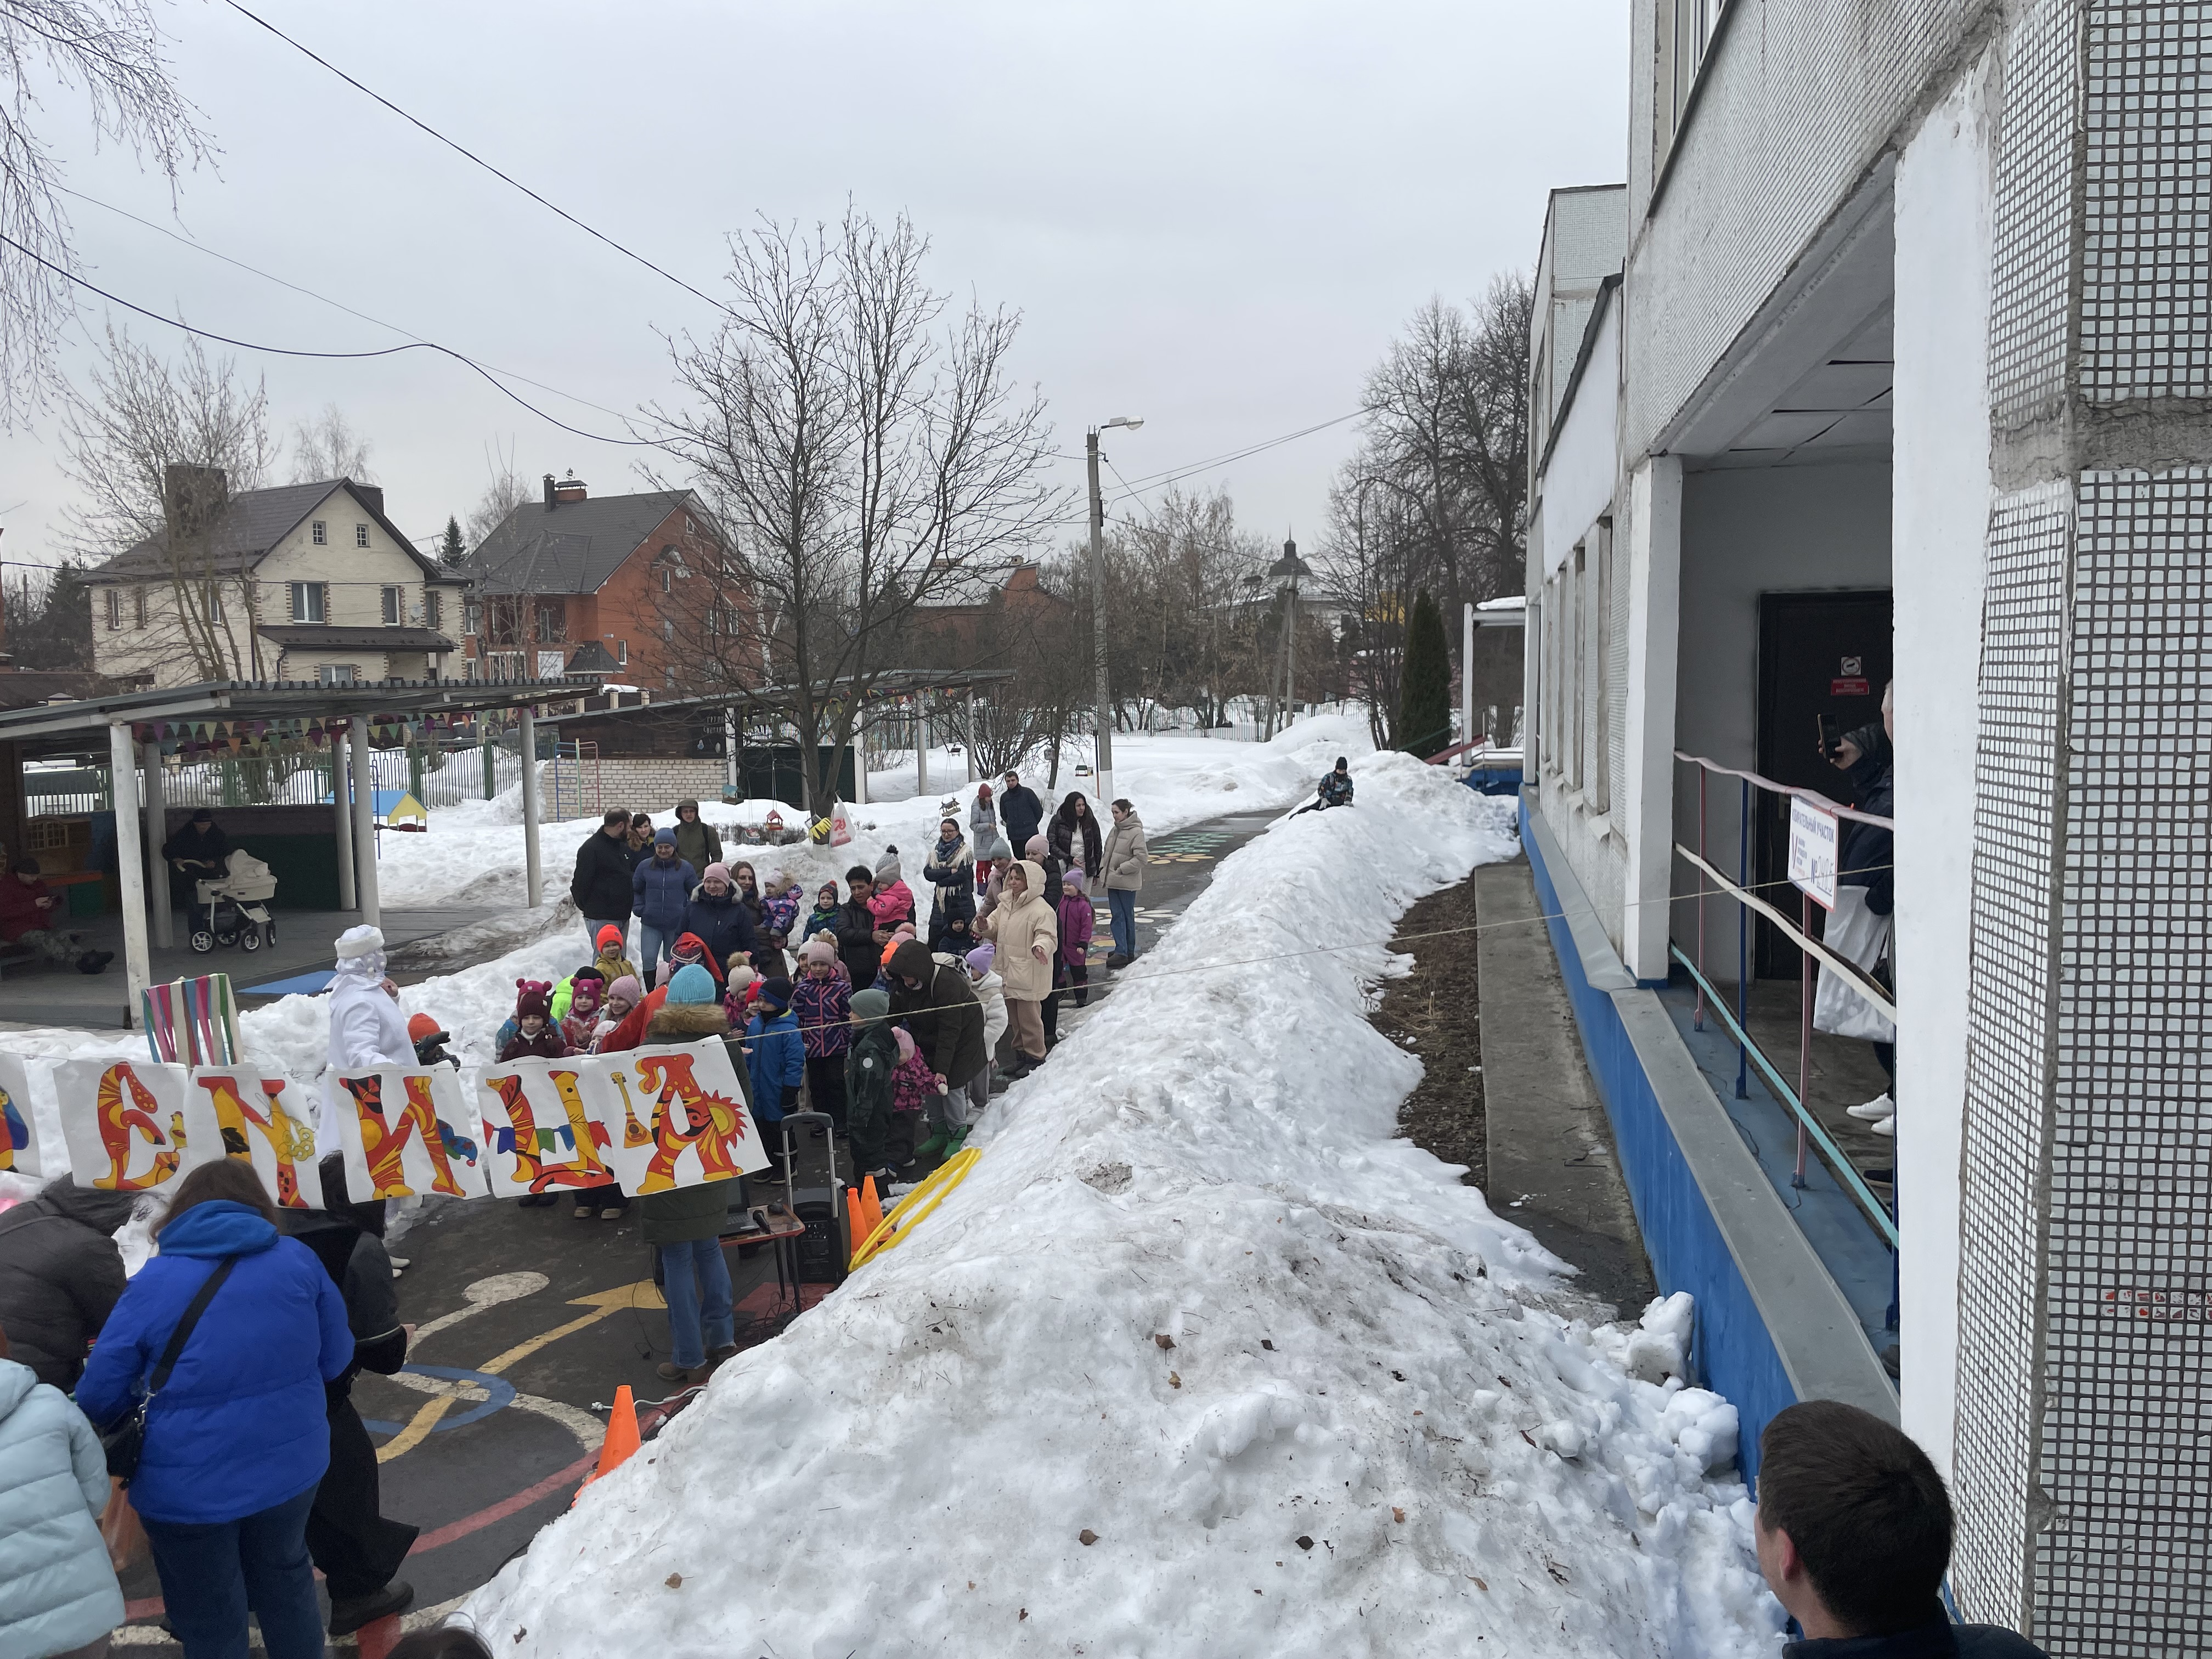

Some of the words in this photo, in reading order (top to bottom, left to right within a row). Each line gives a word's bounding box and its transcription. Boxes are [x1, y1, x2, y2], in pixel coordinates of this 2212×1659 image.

[1792, 809, 1816, 834] ИЗБИРАТЕЛЬНЫЙ
[1816, 821, 1835, 843] УЧАСТОК
[0, 1053, 744, 1209] ЕНИЦА
